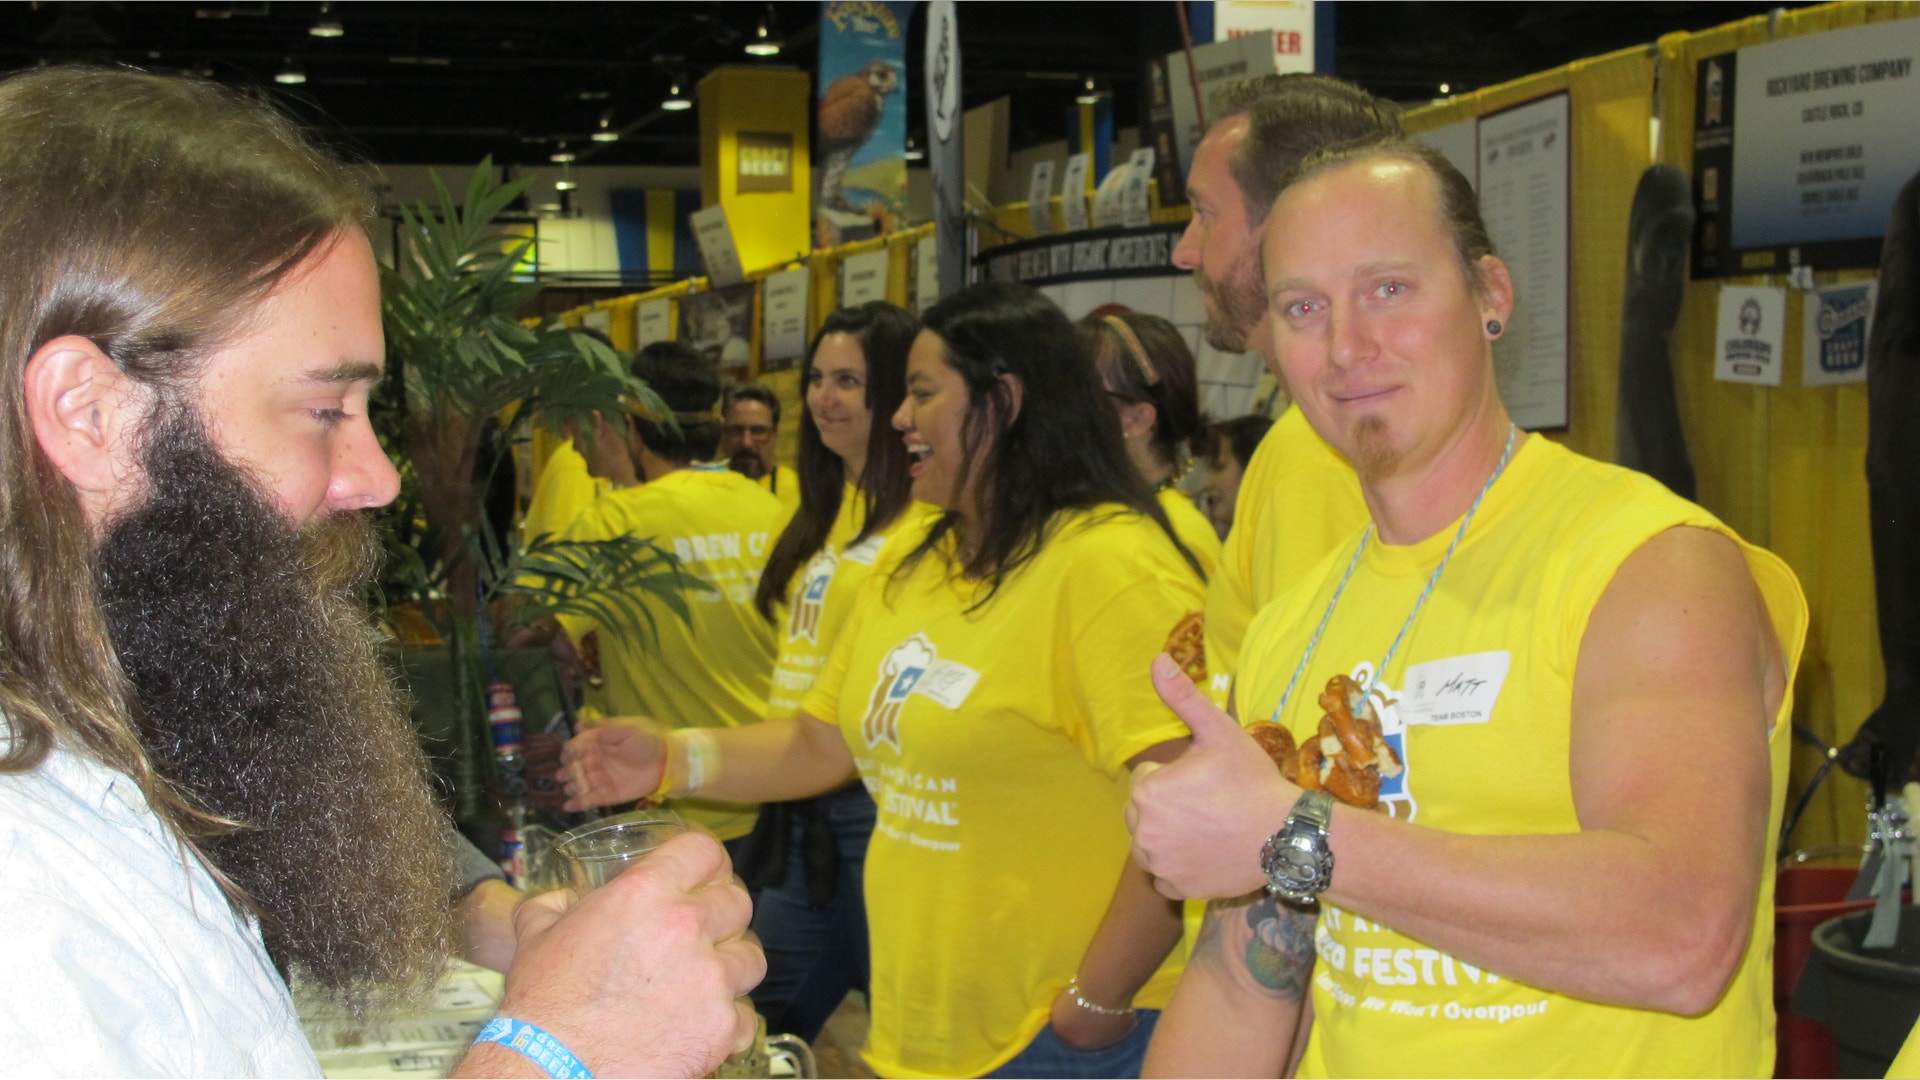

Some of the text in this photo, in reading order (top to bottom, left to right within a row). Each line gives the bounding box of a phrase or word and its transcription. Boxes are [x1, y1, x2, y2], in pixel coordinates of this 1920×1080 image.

[1813, 64, 1857, 91] BREWING
[1859, 57, 1912, 84] COMPANY
[674, 533, 741, 565] BREW
[1435, 672, 1488, 698] MATT
[1431, 710, 1483, 723] TEAM BOSTON
[1353, 946, 1502, 987] FESTIV
[1444, 1000, 1549, 1025] Overpour
[526, 1041, 571, 1080] BEER
[536, 1032, 578, 1069] GREAT
